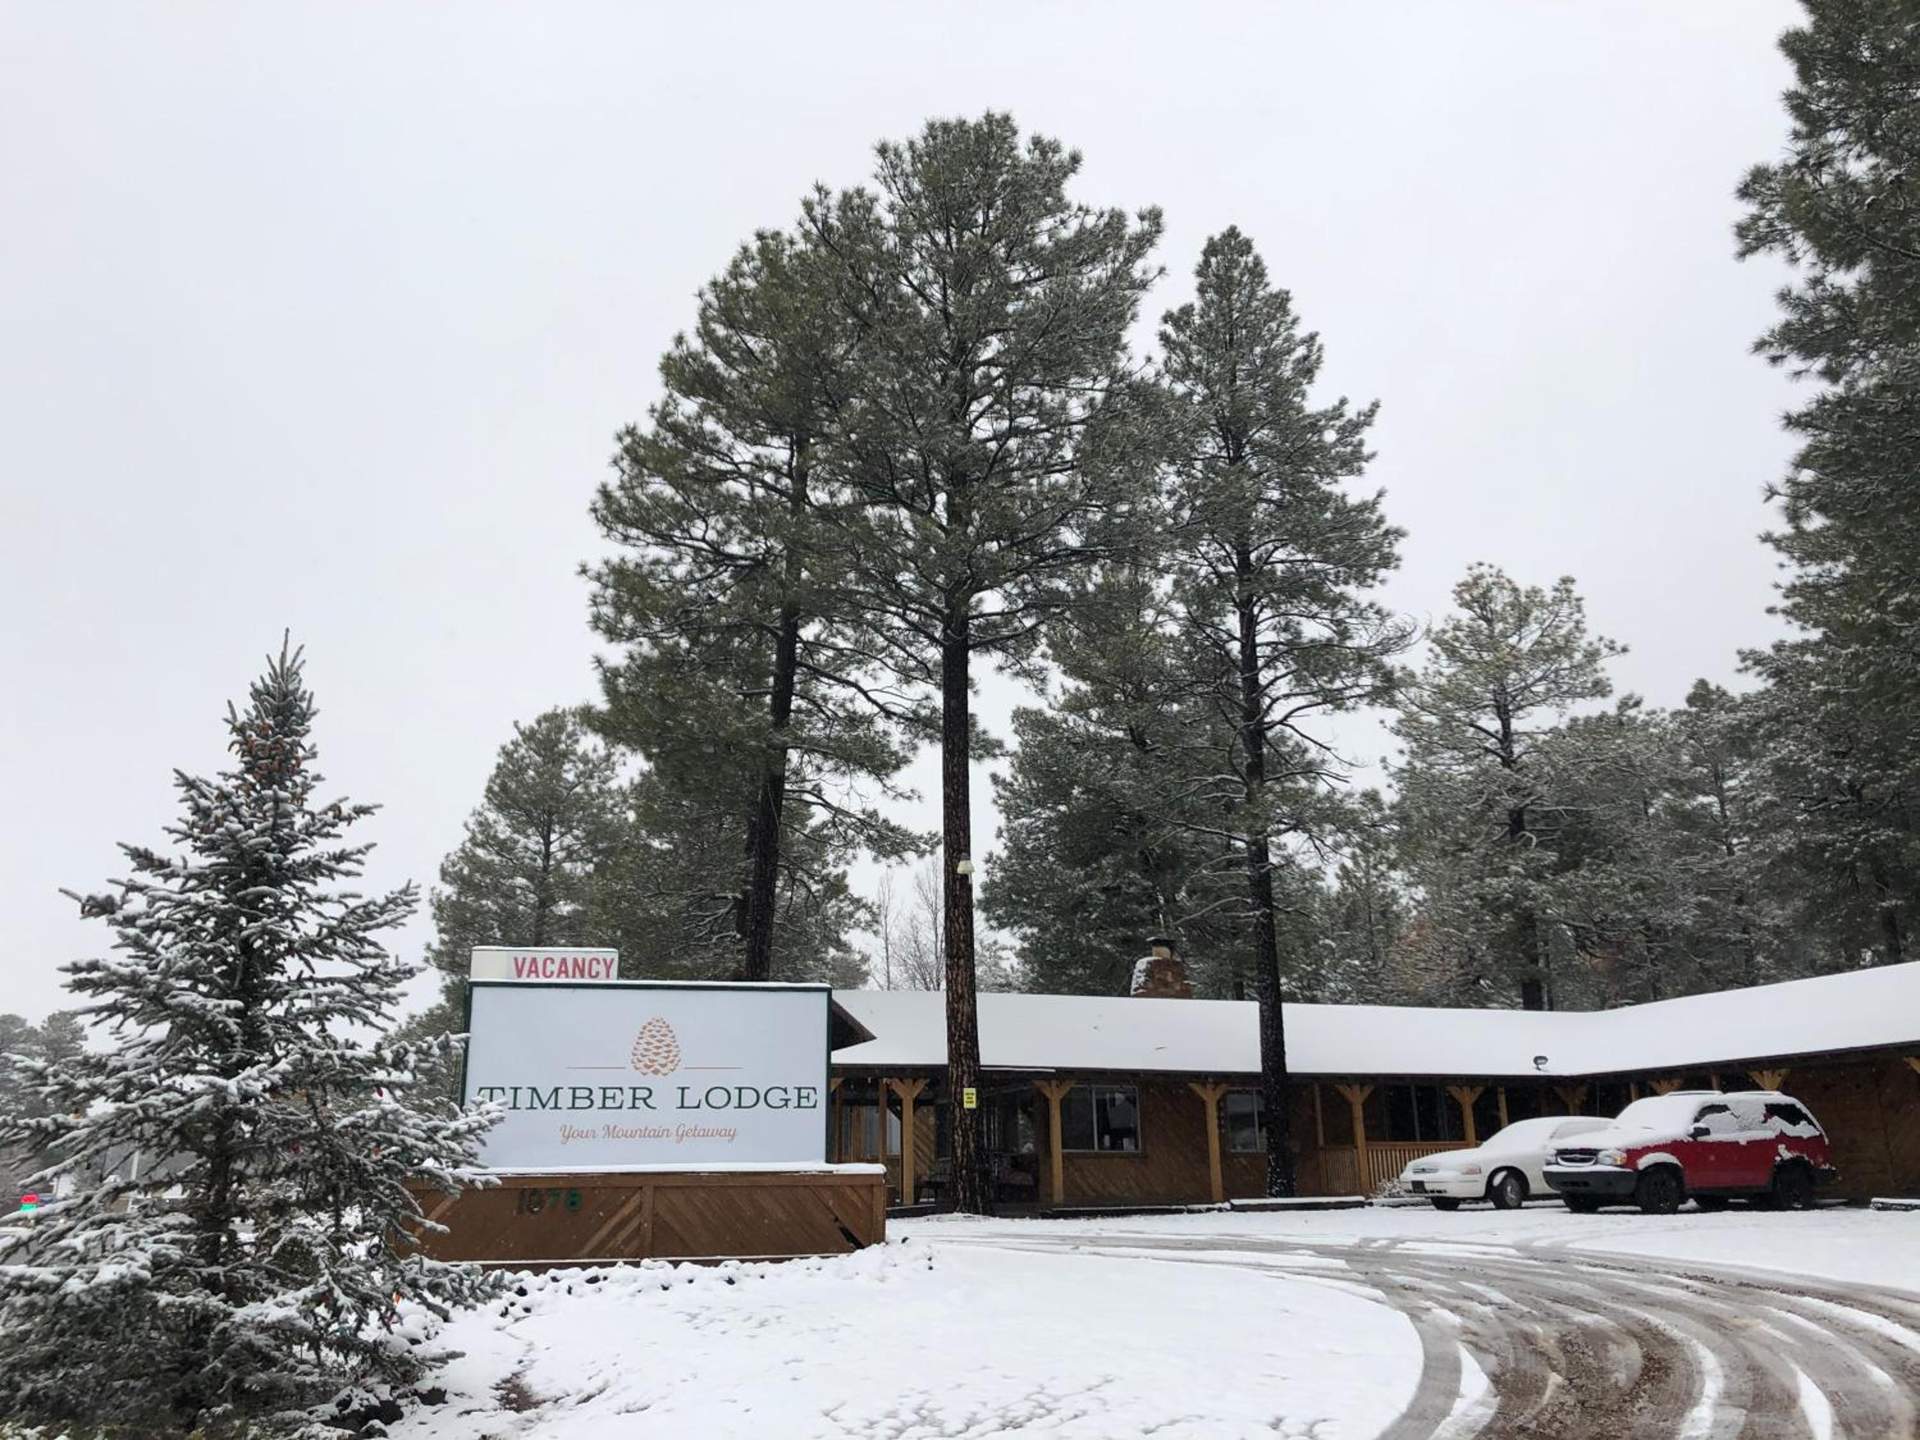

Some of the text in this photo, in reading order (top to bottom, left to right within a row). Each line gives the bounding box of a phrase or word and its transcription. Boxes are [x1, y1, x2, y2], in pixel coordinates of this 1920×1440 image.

[514, 957, 614, 979] VACANCY
[477, 1086, 818, 1110] TIMBER LODGE
[560, 1123, 737, 1144] Your Mountain Getaway
